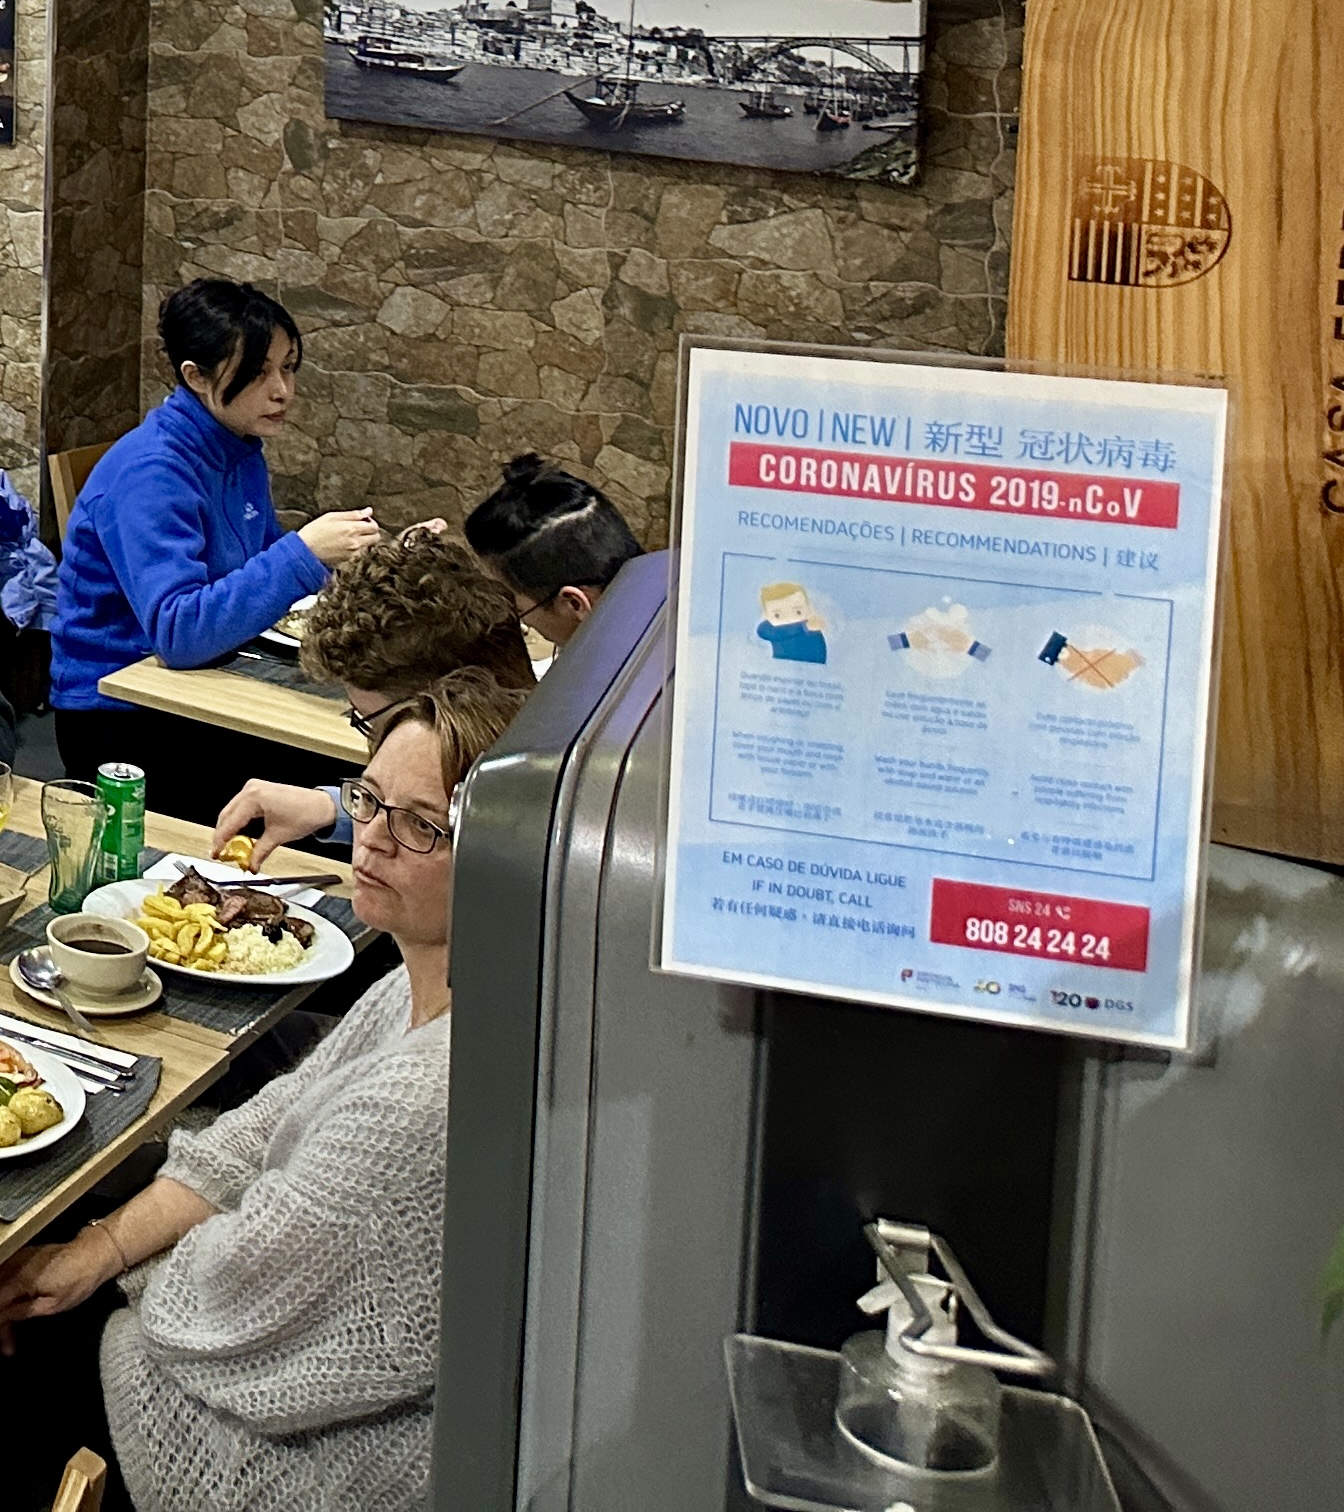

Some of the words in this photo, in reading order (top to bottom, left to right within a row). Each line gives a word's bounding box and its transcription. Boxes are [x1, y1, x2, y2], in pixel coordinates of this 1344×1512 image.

[734, 403, 809, 439] NOVO
[831, 415, 896, 447] NEW
[924, 420, 1004, 459] 新型
[1018, 427, 1177, 473] 冠状病毒
[759, 453, 976, 502] CORONAVÍRUS
[990, 475, 1143, 518] 2019-nCoV
[737, 509, 895, 543] RECOMENDAÇÕES
[911, 528, 1097, 563] RECOMMENDATIONS
[722, 850, 743, 866] EM
[747, 854, 784, 871] CASO
[787, 859, 806, 874] DE
[810, 862, 862, 882] DÚVIDA
[866, 870, 907, 888] LIGUE
[752, 879, 764, 891] IF
[768, 882, 783, 894] IN
[786, 883, 834, 904] DOUBT,
[838, 890, 873, 908] CALL
[1007, 897, 1032, 914] SNS
[1034, 900, 1051, 917] 24
[965, 916, 1009, 945] 808
[1012, 924, 1042, 951] 24
[1046, 929, 1076, 956] 24
[1081, 933, 1111, 961] 24
[1104, 997, 1134, 1013] DGS
